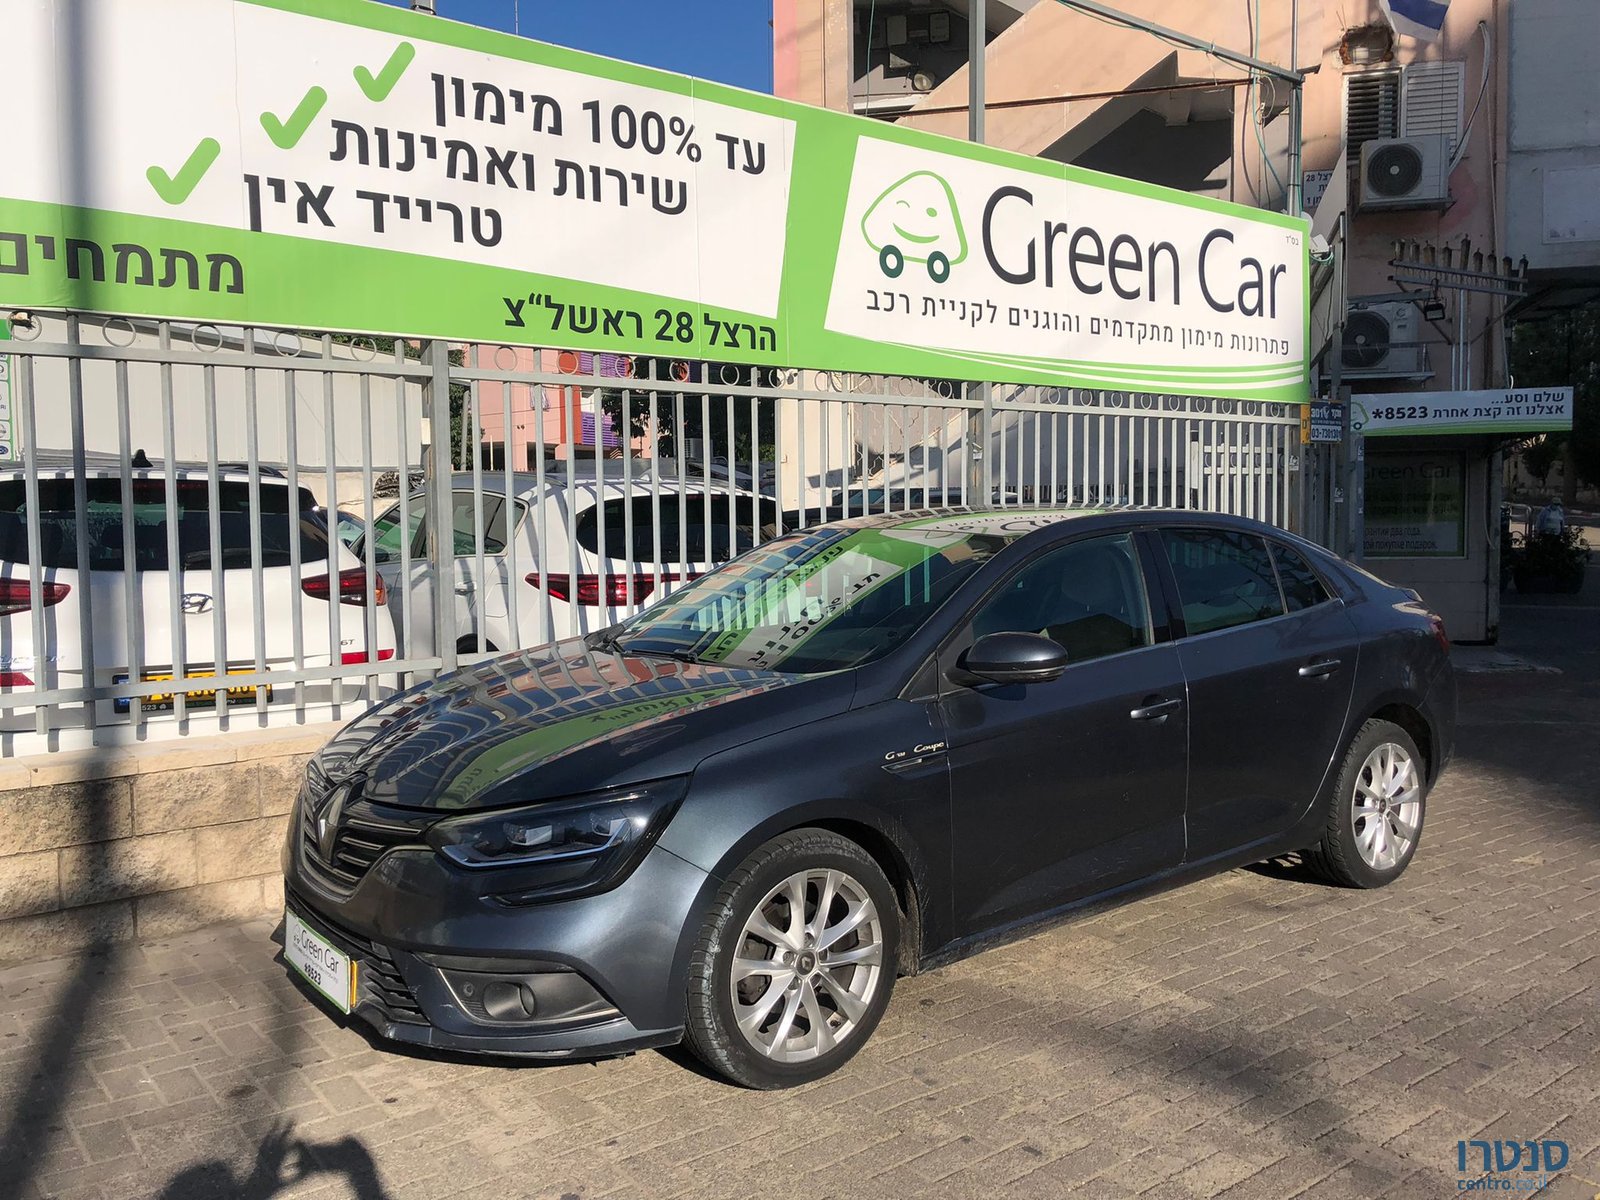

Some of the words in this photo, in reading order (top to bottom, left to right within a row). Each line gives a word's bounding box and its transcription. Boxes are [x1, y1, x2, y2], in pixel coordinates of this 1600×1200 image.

[431, 72, 563, 136] מימון
[582, 100, 702, 163] 100%
[329, 119, 535, 192] ואמינות
[715, 133, 766, 175] עד
[243, 173, 336, 233] אין
[553, 158, 687, 215] שירות
[356, 189, 502, 247] טרייד
[981, 184, 1181, 306] Green
[1198, 227, 1287, 319] Car
[866, 289, 911, 315] רכב
[921, 297, 997, 329] לקניית
[654, 309, 694, 344] 28
[703, 312, 777, 352] הרצל
[1009, 306, 1080, 335] והוגנים
[1090, 317, 1173, 345] מתקדמים
[1182, 328, 1224, 351] מימון
[1230, 333, 1290, 357] פתרונות
[1432, 409, 1469, 419] אחרת
[1473, 407, 1502, 421] קצת
[1506, 407, 1522, 417] זה
[1526, 404, 1565, 416] אצלנו
[1534, 391, 1565, 404] שלם
[301, 929, 324, 963] Green
[324, 948, 339, 974] Car
